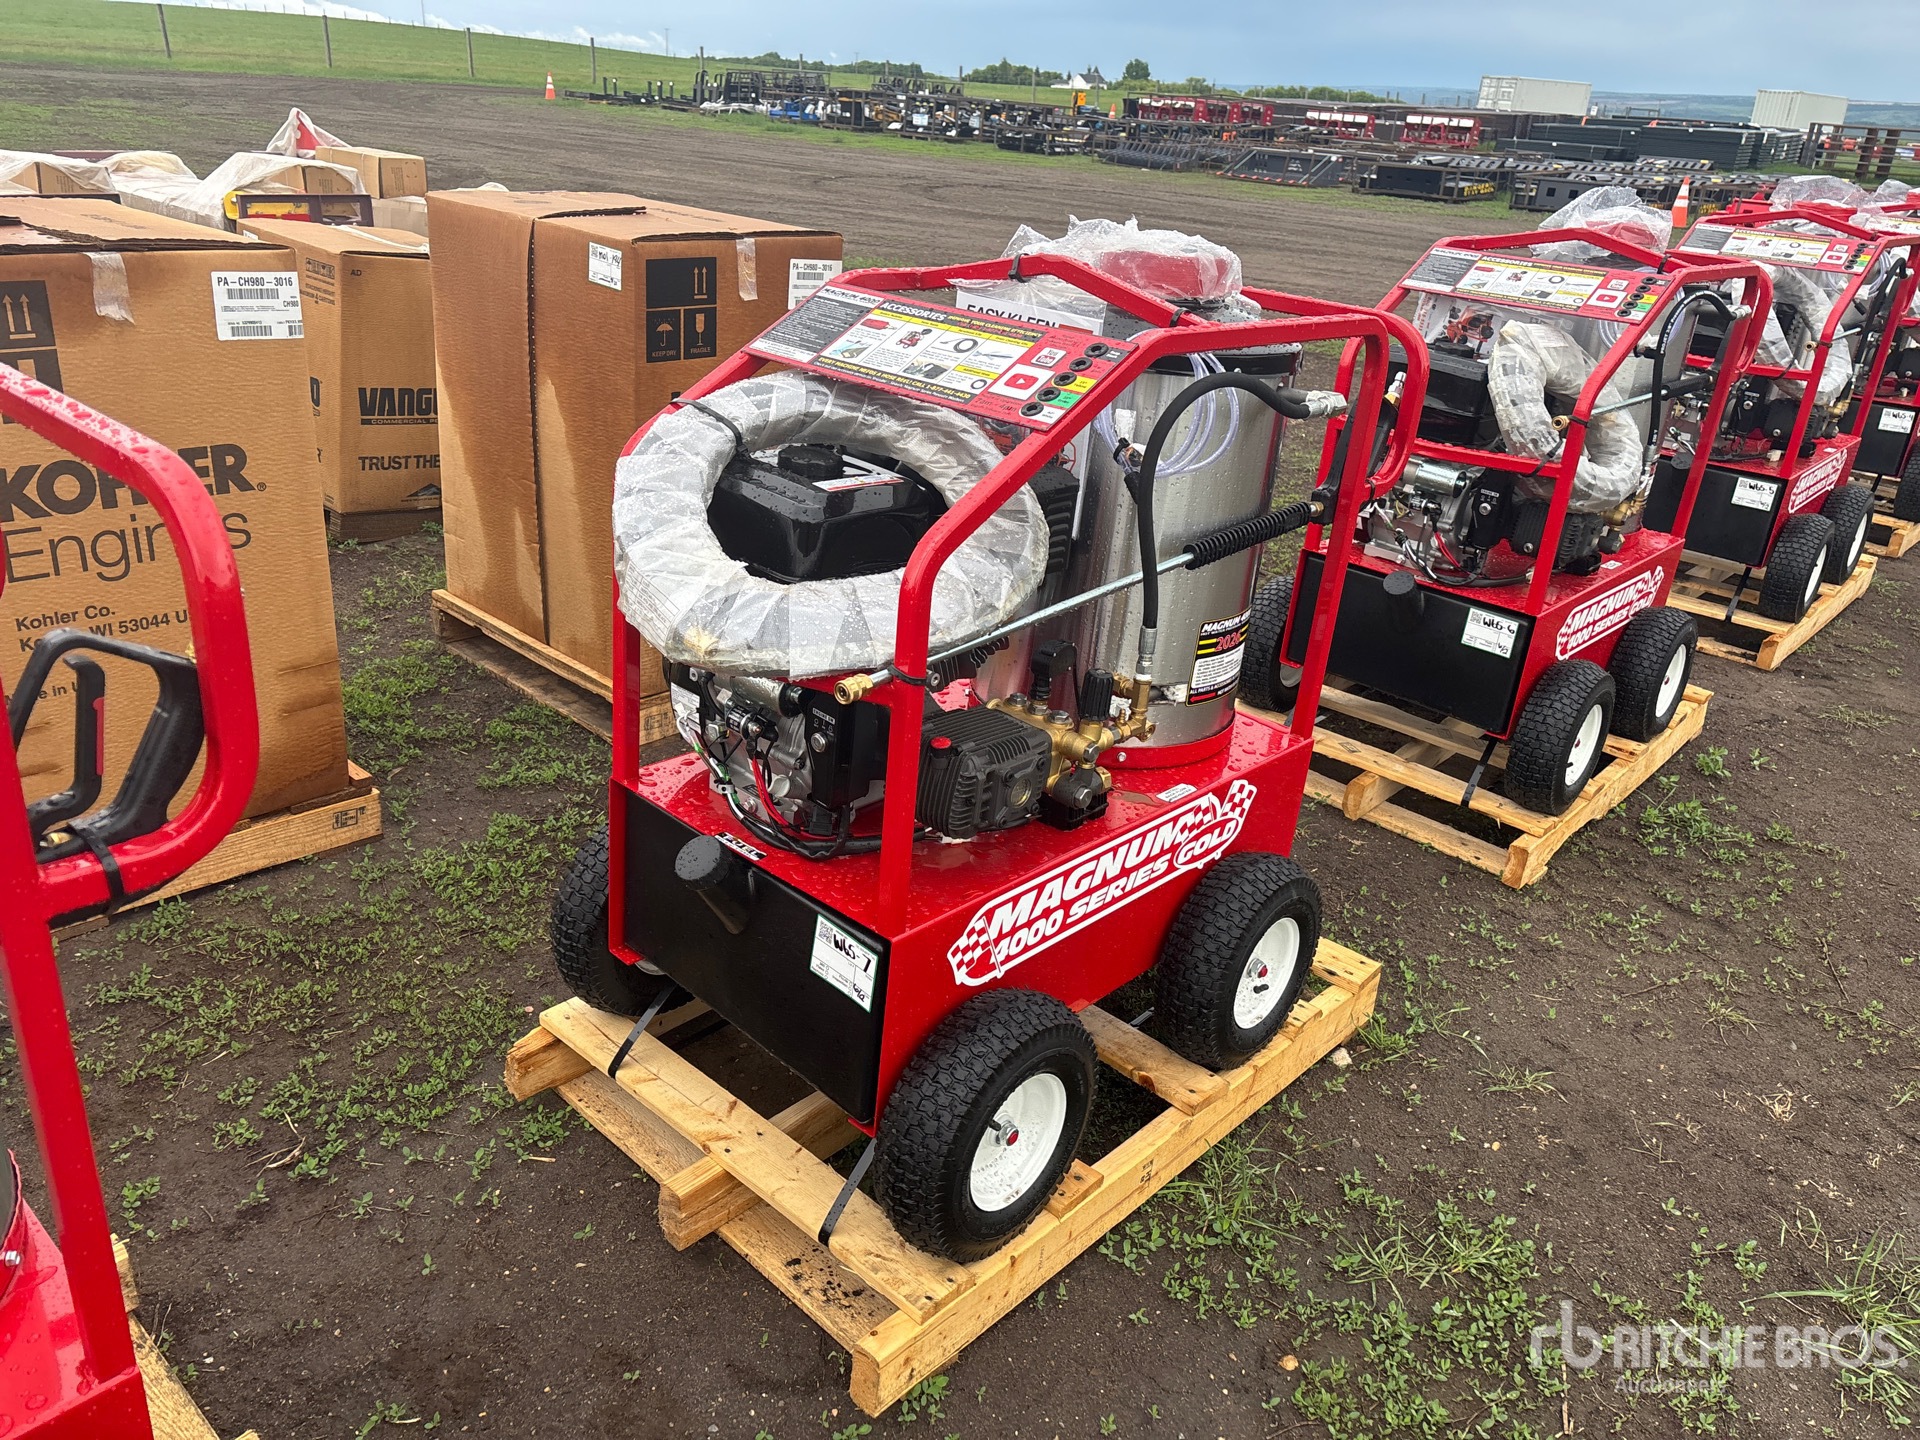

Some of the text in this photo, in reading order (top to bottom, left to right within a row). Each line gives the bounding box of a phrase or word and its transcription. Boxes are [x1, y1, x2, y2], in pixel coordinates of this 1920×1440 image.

[1482, 256, 1533, 266] ACCESSORIES
[880, 302, 947, 321] ACCESSORIES
[985, 323, 1011, 331] CLEANING
[1011, 328, 1042, 337] EFFICIENCY
[835, 362, 860, 370] MACHINE
[859, 367, 877, 375] NEEDS
[358, 454, 440, 471] TRUST THE
[0, 443, 256, 522] KOHER
[1569, 582, 1641, 633] MAGNUM
[16, 605, 116, 632] Kohler Co.
[119, 614, 170, 634] 53044
[1201, 616, 1241, 632] MAGNUM
[1567, 606, 1630, 649] 4000 SERIES
[1215, 630, 1242, 652] 2026
[53, 685, 67, 696] in
[812, 708, 827, 721] ENGINE
[1179, 820, 1236, 863] GOLD
[988, 814, 1194, 938] MAGNUM
[990, 852, 1172, 966] 4000 SERIES
